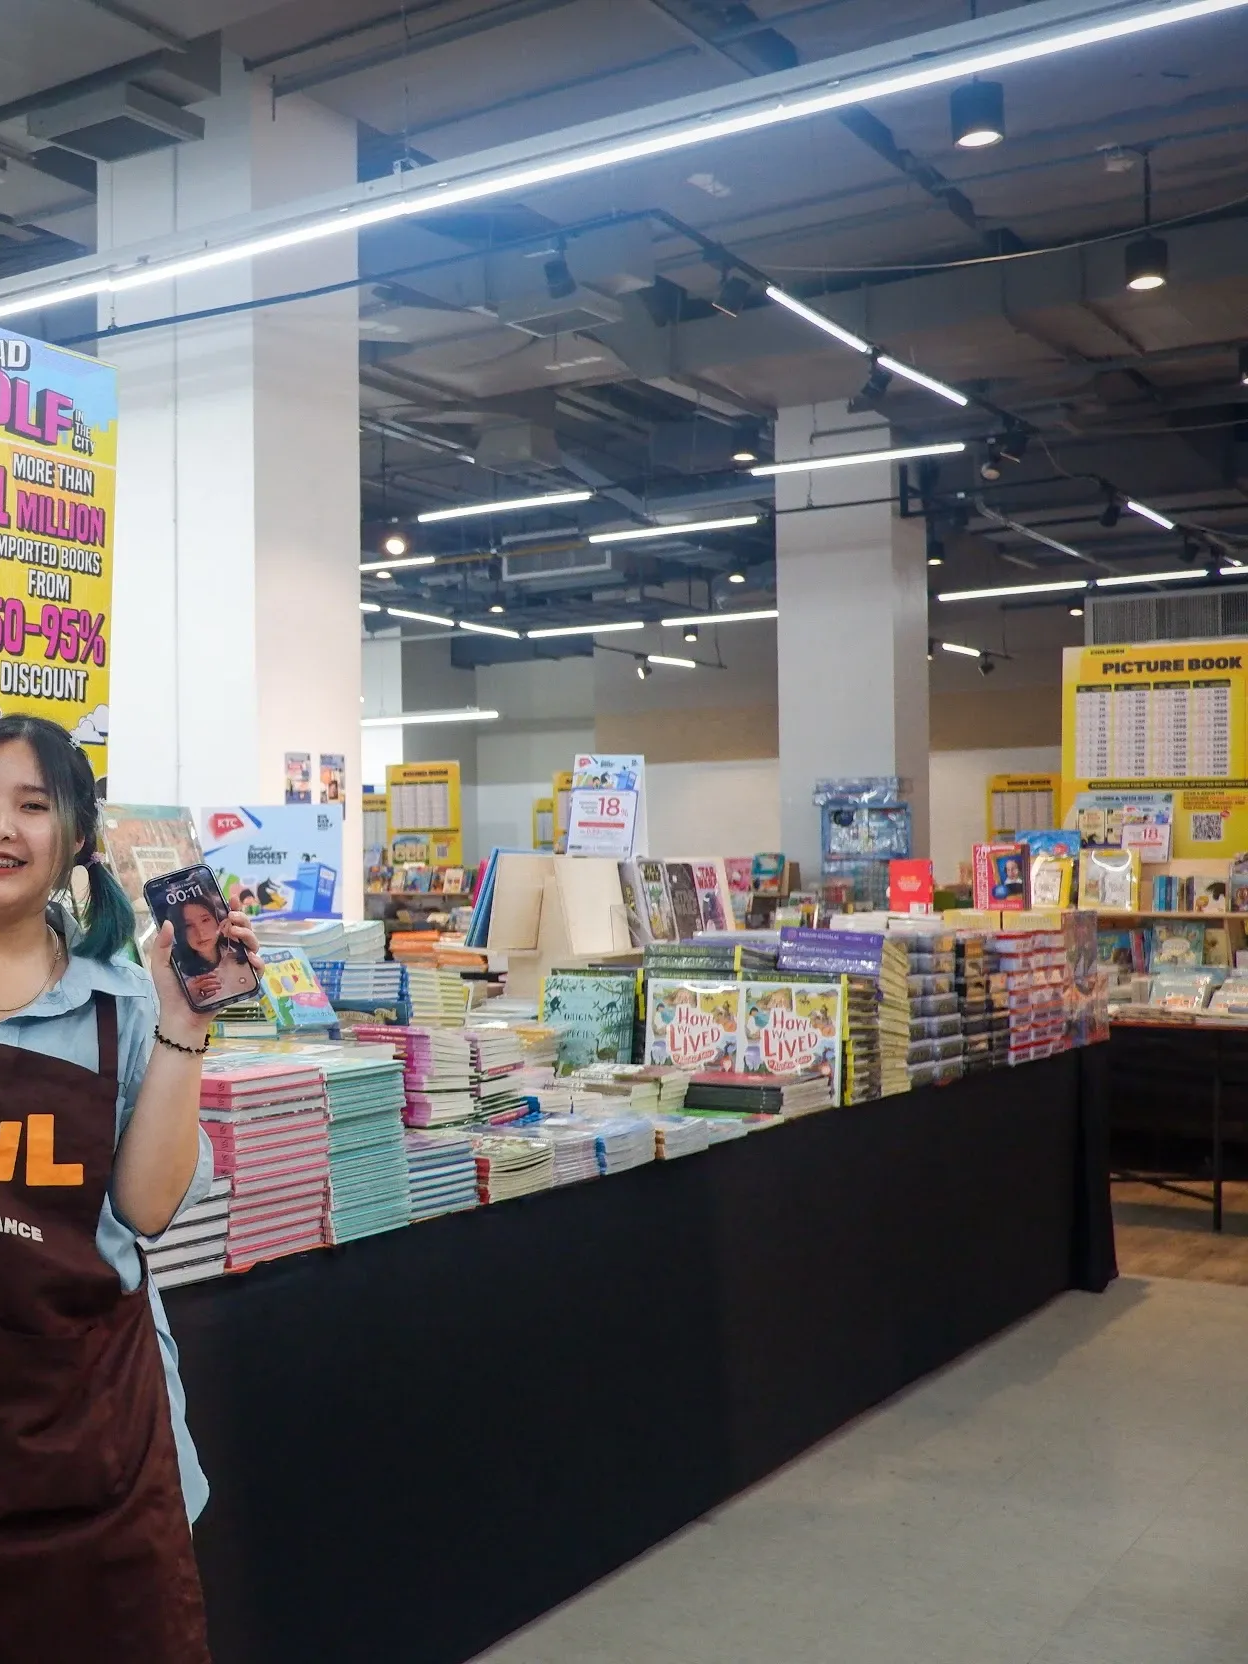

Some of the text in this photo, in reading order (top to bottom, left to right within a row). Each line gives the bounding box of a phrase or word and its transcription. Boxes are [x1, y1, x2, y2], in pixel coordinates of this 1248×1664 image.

[74, 409, 84, 423] IN
[74, 422, 91, 440] THE
[73, 435, 96, 454] CITY
[13, 452, 94, 496] MORE THAN
[16, 490, 105, 548] MILLION
[60, 546, 102, 575] BOOKS
[28, 570, 71, 602] FROM
[1102, 656, 1242, 674] PICTURE BOOK
[0, 661, 89, 703] DISCOUNT
[217, 818, 238, 829] KTC
[248, 851, 288, 859] BIGGEST
[166, 884, 203, 905] 00:11
[670, 1024, 721, 1056] LIVED
[764, 1029, 818, 1061] LIVED
